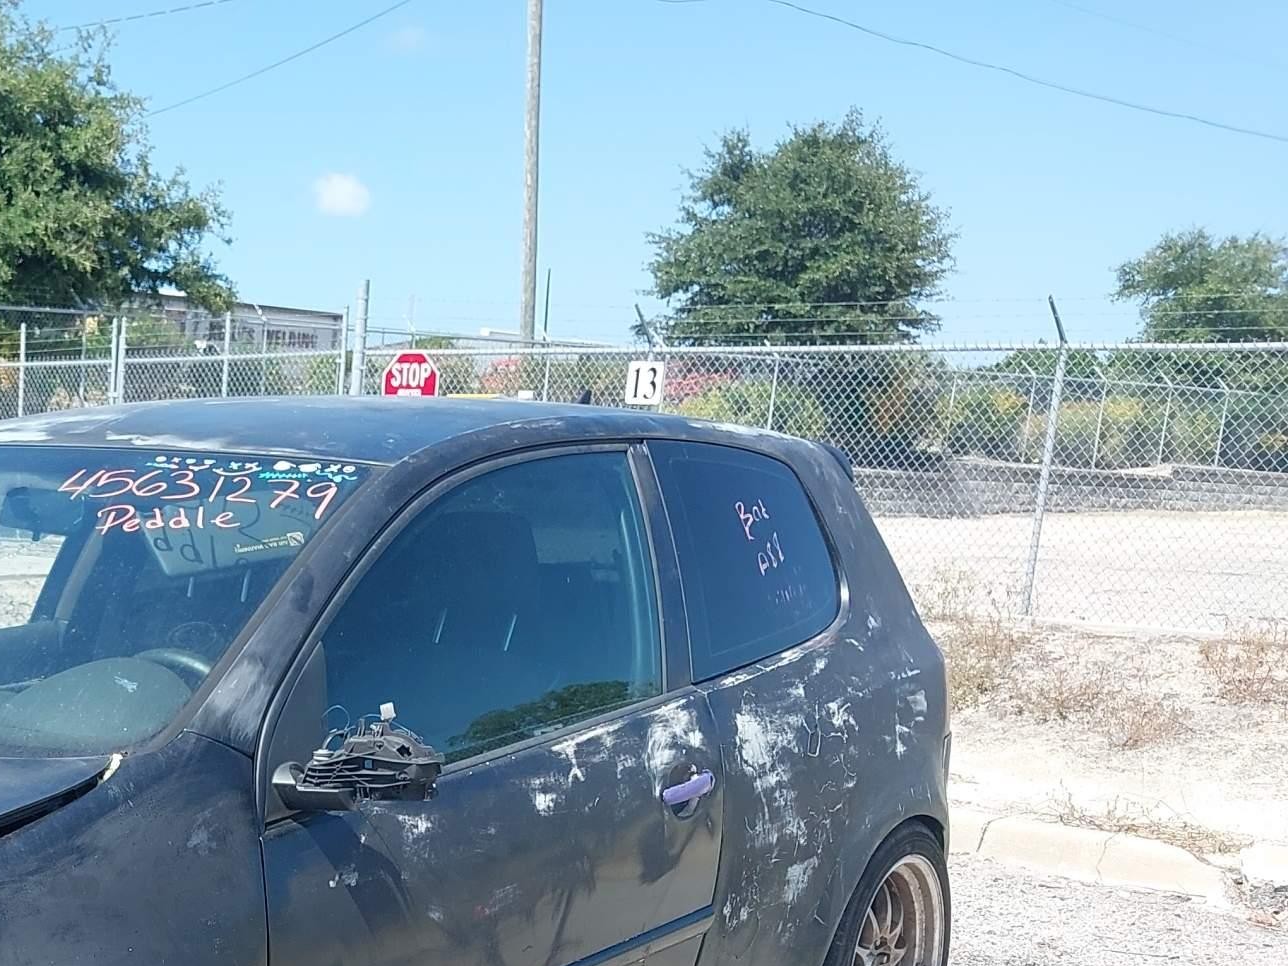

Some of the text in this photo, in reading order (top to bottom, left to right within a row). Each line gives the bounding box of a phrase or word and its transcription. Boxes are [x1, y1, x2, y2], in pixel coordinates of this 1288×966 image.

[390, 362, 432, 388] STOP
[633, 367, 657, 400] 13
[57, 468, 339, 519] 45631279
[96, 504, 241, 535] Peddle
